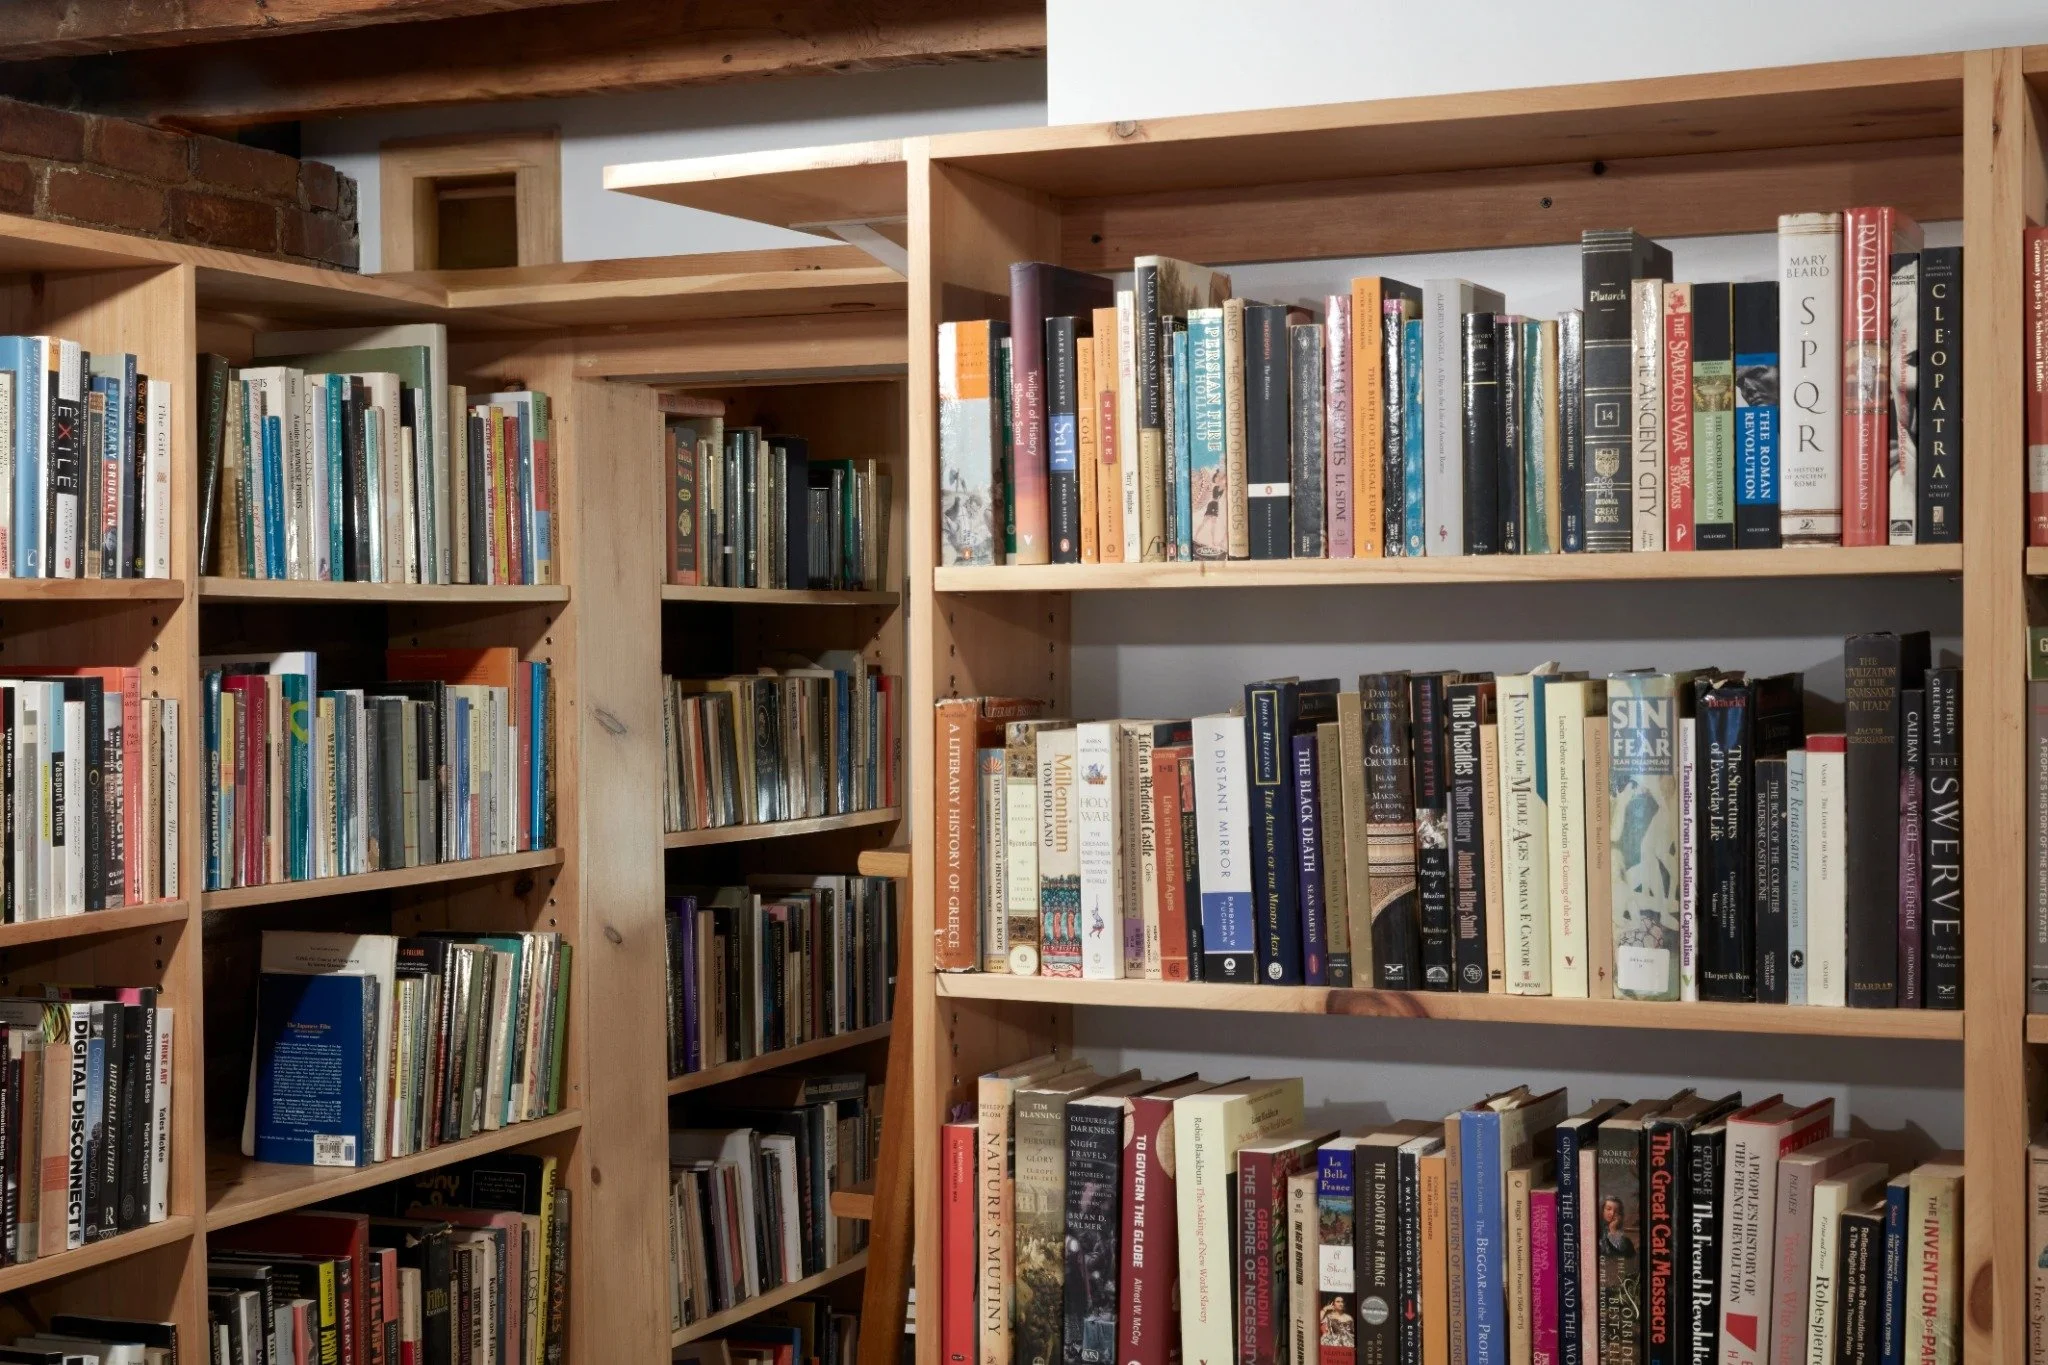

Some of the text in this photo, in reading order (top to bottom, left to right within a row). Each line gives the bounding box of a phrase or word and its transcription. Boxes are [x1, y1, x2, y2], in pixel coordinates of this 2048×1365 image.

[1786, 268, 1829, 276] BEARD
[1790, 257, 1828, 266] MARY
[1857, 224, 1875, 332] RVBICON
[2034, 240, 2043, 275] Germany
[1148, 306, 1156, 314] A
[1590, 292, 1626, 300] Plutarch
[2034, 279, 2042, 309] 1918-19
[2035, 321, 2044, 359] Sebastian
[1195, 340, 1207, 440] TOM HOLLAND
[1206, 327, 1221, 451] PERSIAN FIRE
[1669, 317, 1688, 452] THE SPARTACUS WAR
[158, 403, 166, 457] The Gift
[1015, 383, 1023, 445] Shlomo Sand
[1027, 370, 1038, 455] Twilight of History
[1080, 417, 1093, 445] cod
[1104, 400, 1112, 456] SPICE
[58, 407, 72, 487] EXILE
[108, 400, 116, 526] LITERARY BROOKLYN
[1054, 422, 1071, 463] Salt
[1639, 384, 1656, 517] ANCIENT CITY
[1744, 412, 1755, 499] REVOLUTION
[1759, 411, 1770, 498] THE ROMAN
[1860, 422, 1869, 510] TOM HOLLAND
[73, 473, 79, 487] IN
[1670, 466, 1681, 509] STRAUSS
[1680, 457, 1690, 487] BARRY
[1452, 696, 1475, 718] The
[1612, 701, 1667, 729] SIN
[1932, 678, 1941, 745] GREENBLATT
[1946, 688, 1954, 735] STEPHEN
[1139, 733, 1152, 752] Life
[1140, 755, 1152, 764] in
[1454, 721, 1476, 775] Crusades
[1614, 738, 1671, 757] FEAR
[55, 762, 64, 836] Passport Photos
[328, 789, 336, 801] IN
[1044, 761, 1053, 847] TOM HOLLAND
[1055, 754, 1071, 853] Millennium
[1141, 776, 1153, 823] Medieval
[1455, 786, 1476, 809] Short
[1708, 743, 1722, 841] of Everyday Life
[1728, 746, 1741, 838] The Structures
[1906, 712, 1918, 841] CALIBAN AND THE WITCH
[1215, 733, 1230, 877] A DISTANT MIRROR
[1298, 749, 1315, 872] THE BLACK DEATH
[1455, 812, 1476, 843] History
[116, 822, 124, 862] CITY
[949, 724, 960, 948] A LITERARY HISTORY OF GREECE
[1142, 827, 1153, 857] Castle
[1931, 777, 1960, 936] SWERVE
[1682, 763, 1693, 966] Transition from Feudalism to Capitalism
[1458, 850, 1479, 939] Jonathan Riley-Smith
[1308, 908, 1316, 942] MARTIN
[144, 1008, 153, 1059] Everything
[160, 1033, 169, 1085] STRIKE ART
[144, 1083, 152, 1104] Less
[69, 1020, 87, 1227] DIGITAL DISCONNECT
[107, 1063, 118, 1183] IMPERIAL LEATHER
[158, 1107, 167, 1163] Yates McKee
[142, 1123, 151, 1184] Mark McGurl
[1374, 1163, 1386, 1180] THE
[1133, 1135, 1147, 1268] TO GOVERN THE GLOBE
[1375, 1183, 1386, 1236] DISCOVERY
[1748, 1163, 1759, 1220] PEOPLE'S
[1788, 1174, 1798, 1215] PALMER
[987, 1133, 1001, 1336] NATURE'S MUTINY
[1652, 1133, 1671, 1343] The Great Cat Massacre
[1730, 1142, 1745, 1303] THE FRENCH REVOLUTION
[1375, 1251, 1386, 1286] FRANCE
[1746, 1223, 1757, 1278] HISTORY
[528, 1270, 538, 1317] LOSEY
[1130, 1279, 1142, 1345] Alfred W. McCoy
[1745, 1281, 1756, 1295] OF
